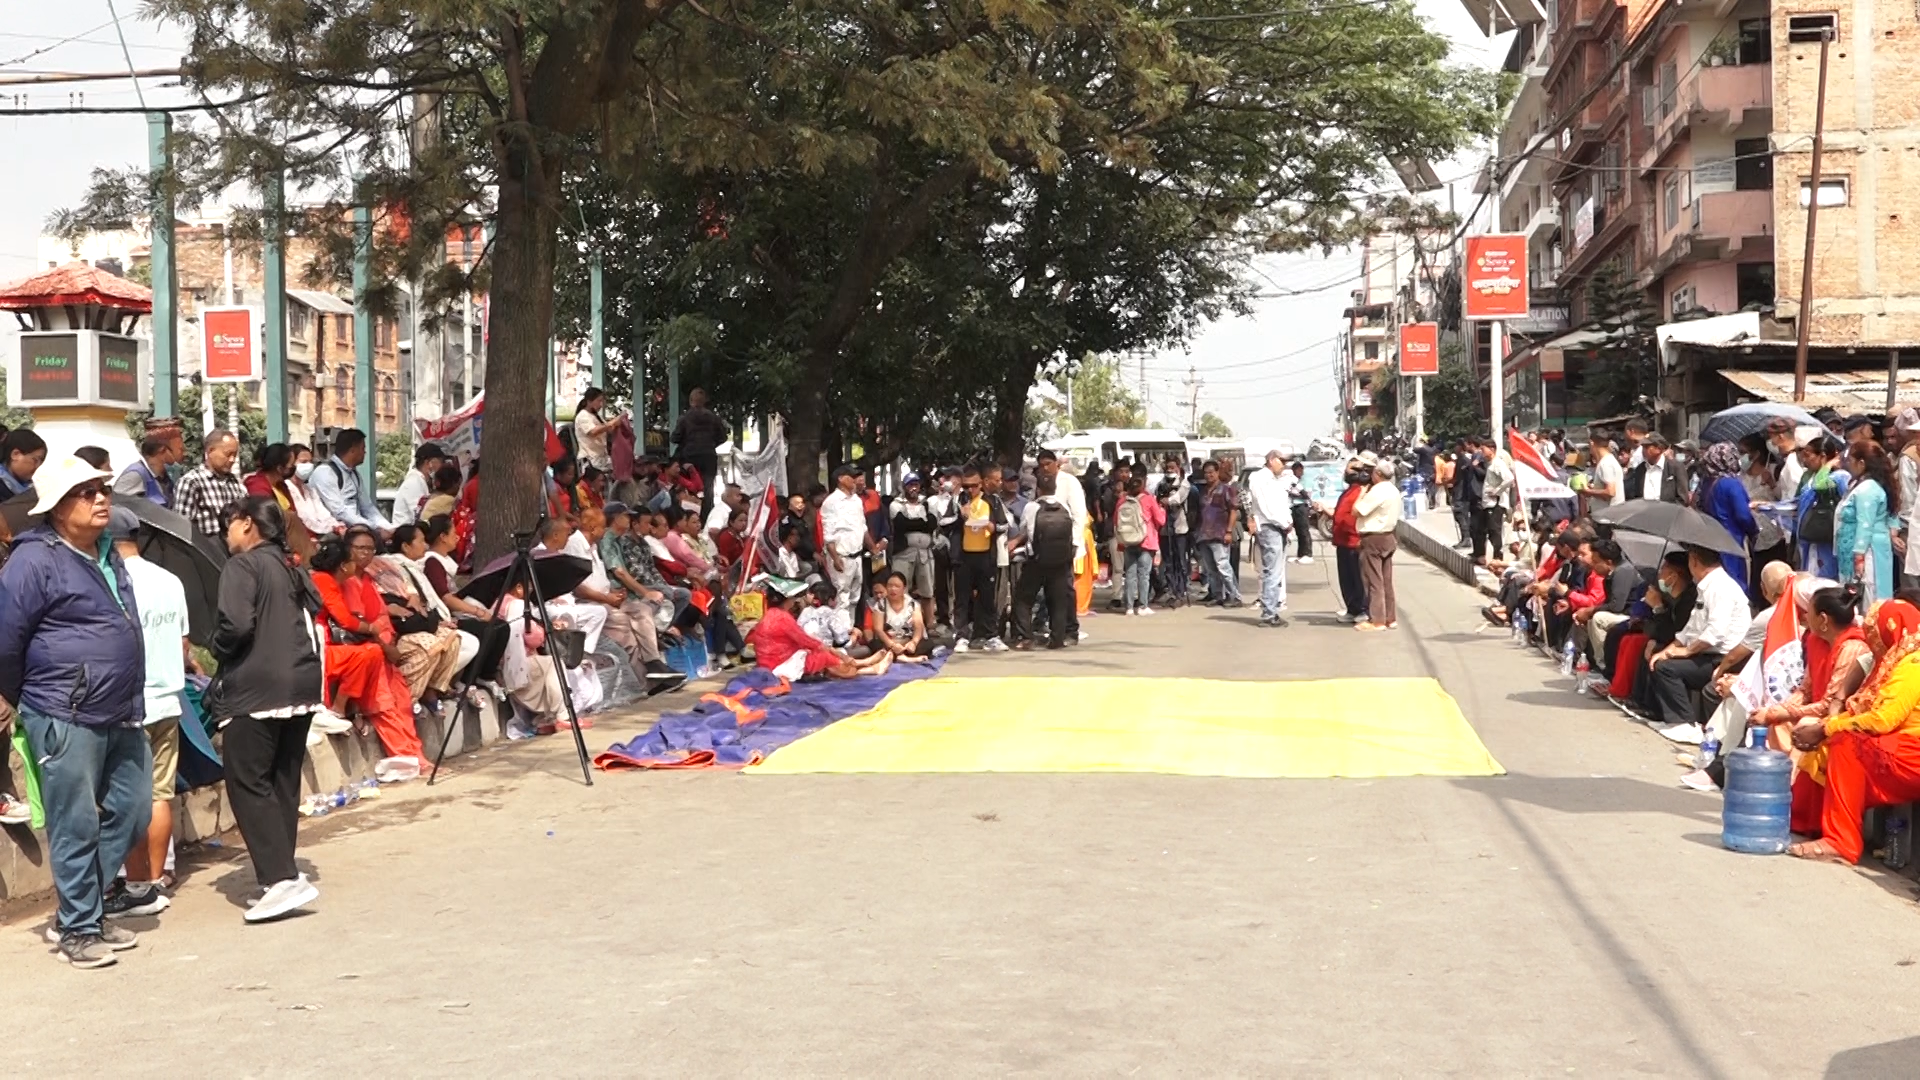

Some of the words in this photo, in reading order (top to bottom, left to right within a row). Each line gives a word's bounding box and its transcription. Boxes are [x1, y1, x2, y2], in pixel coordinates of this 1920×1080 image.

[1530, 307, 1569, 321] SLATION
[34, 356, 68, 368] Friday
[105, 357, 130, 371] Friday
